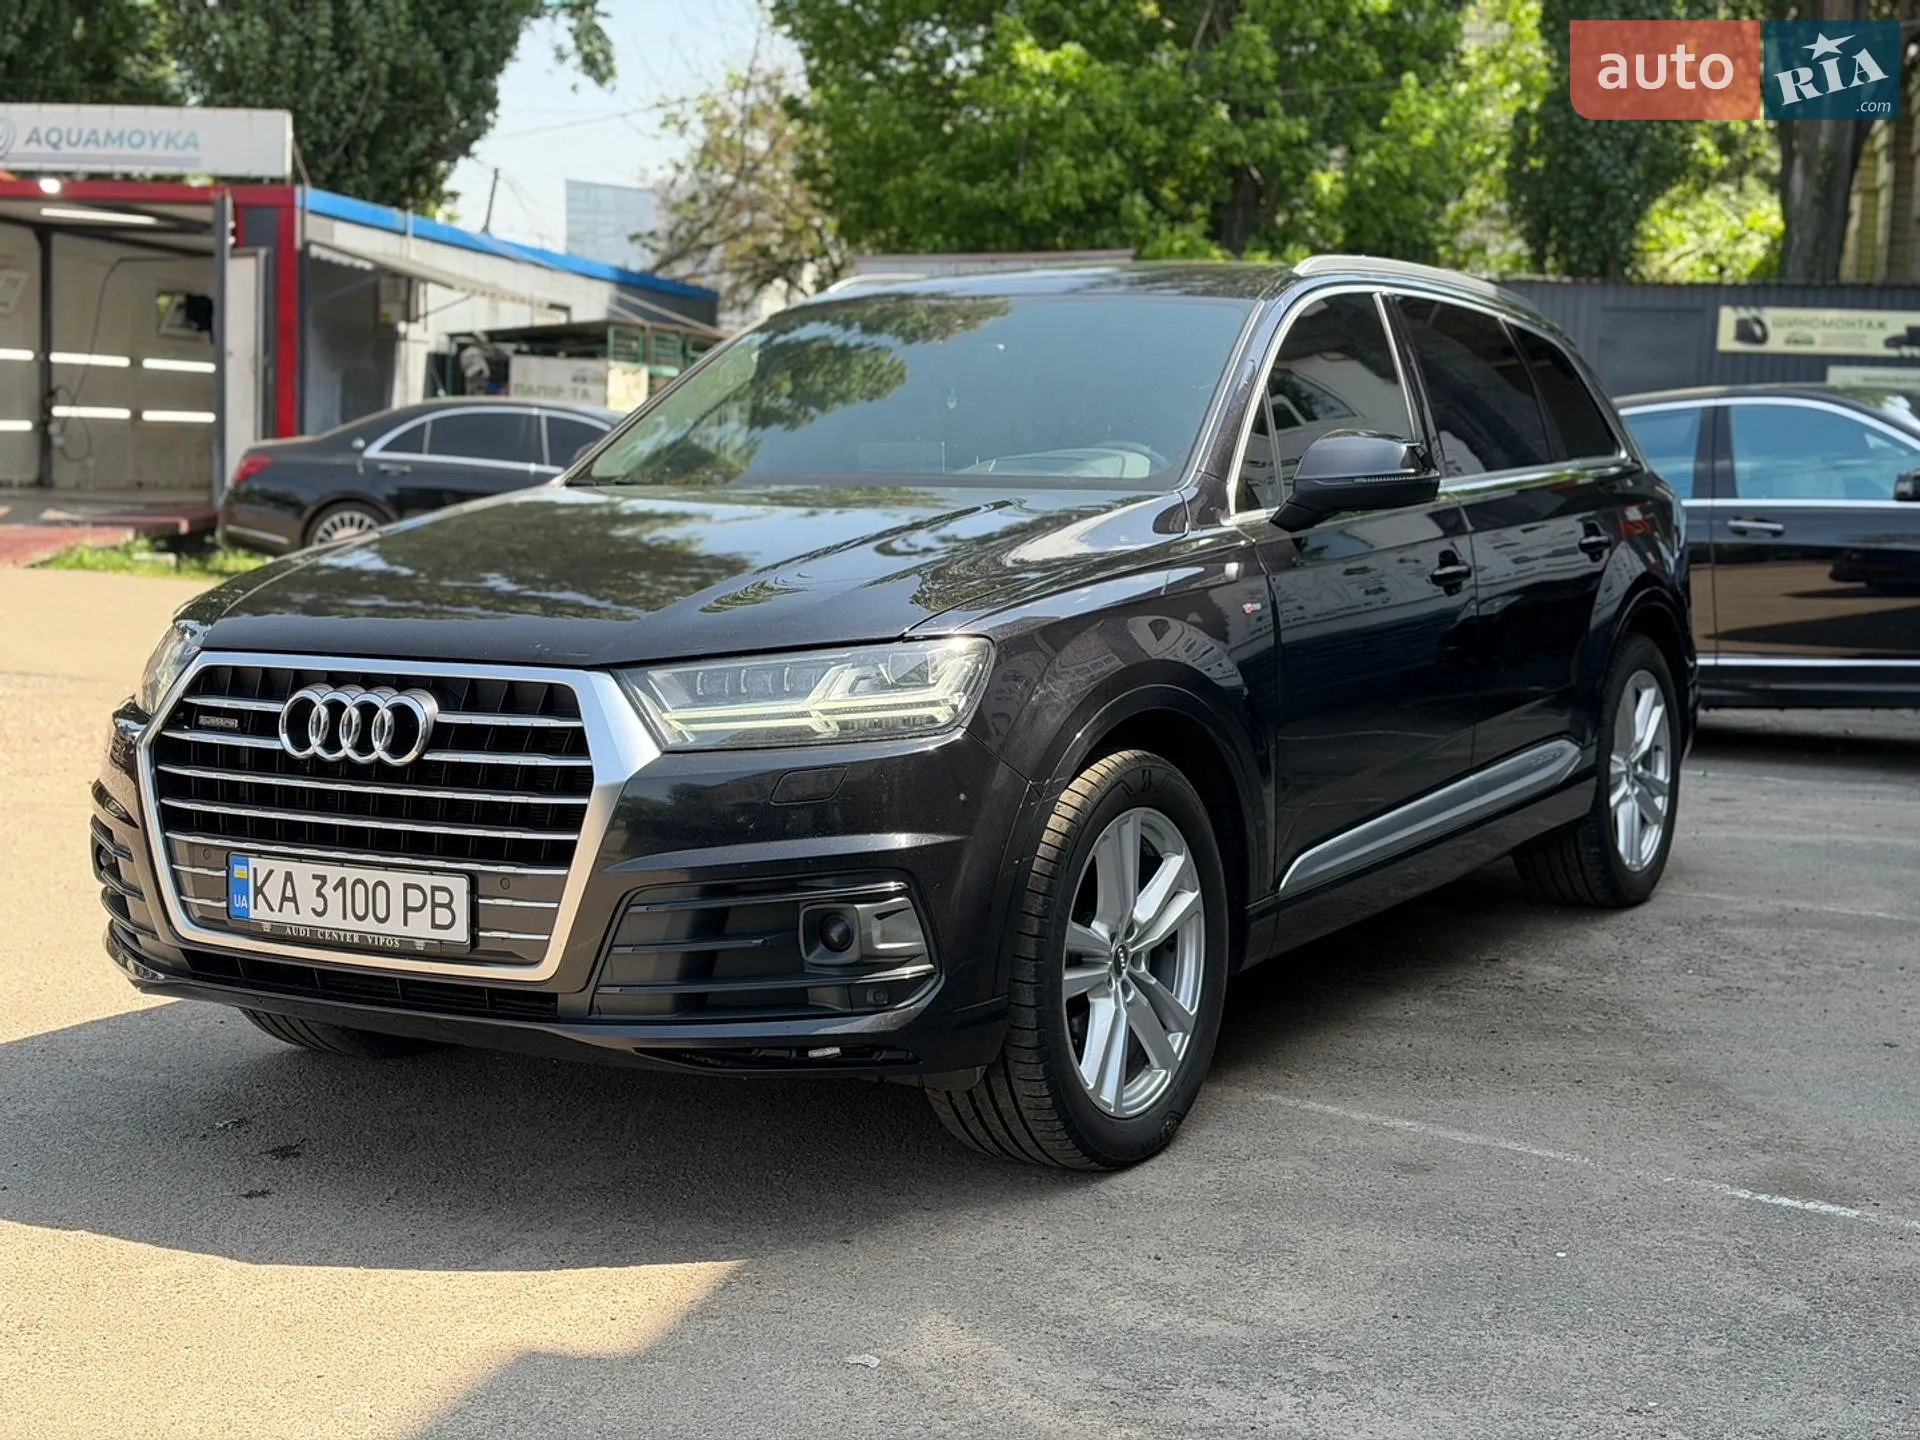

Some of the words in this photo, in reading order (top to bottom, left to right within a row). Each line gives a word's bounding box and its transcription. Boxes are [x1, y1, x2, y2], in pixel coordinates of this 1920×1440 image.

[25, 126, 200, 150] AQUAMOYKA
[234, 894, 248, 910] UA
[253, 867, 300, 915] KA
[310, 874, 391, 924] 3100
[402, 882, 456, 931] PB
[285, 926, 311, 937] AUDI
[317, 929, 360, 944] CENTER
